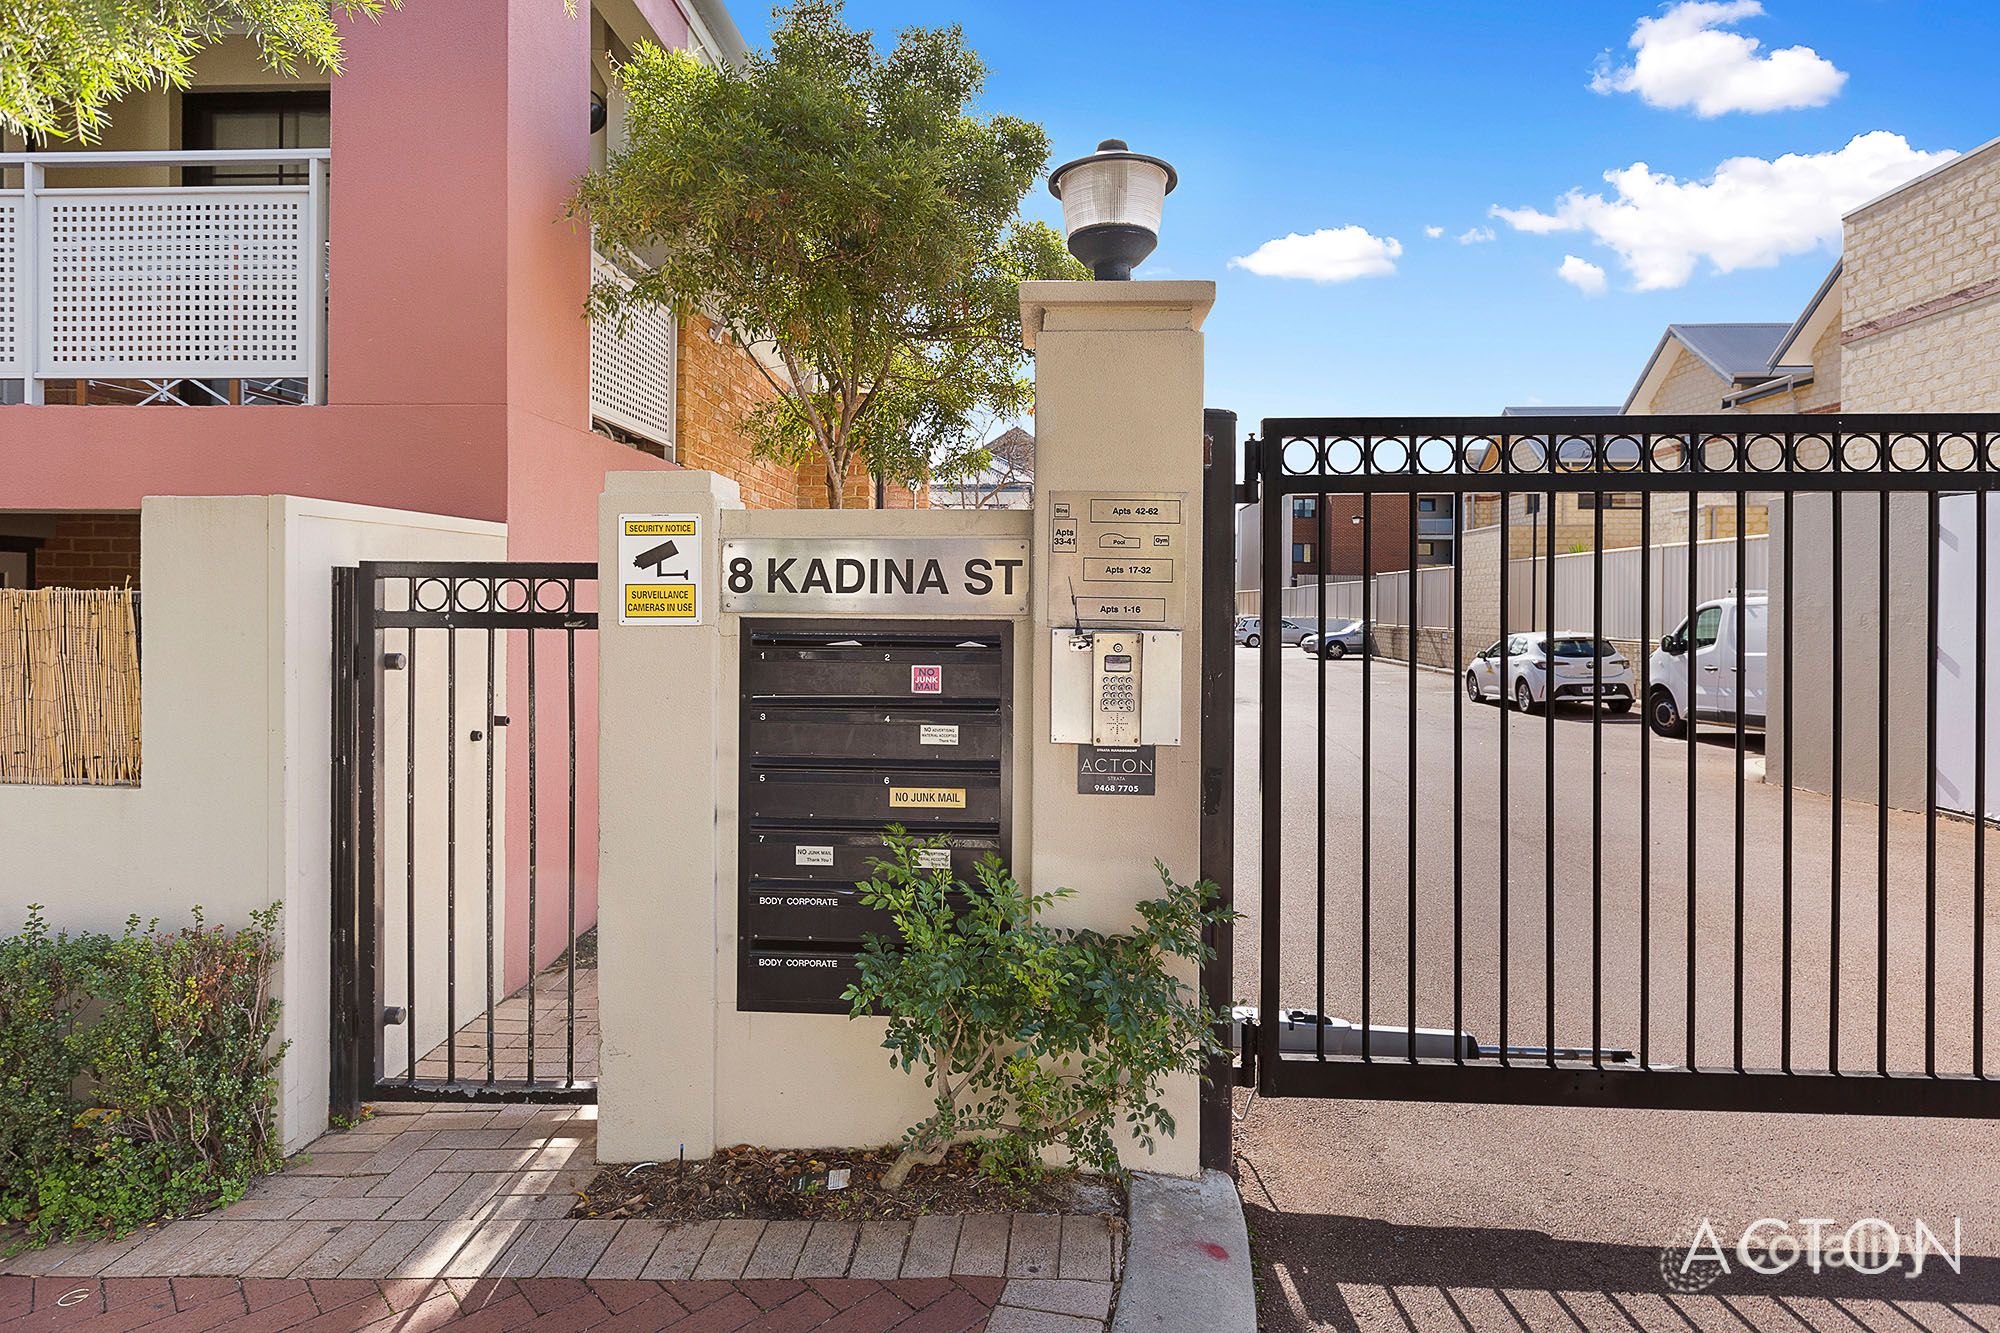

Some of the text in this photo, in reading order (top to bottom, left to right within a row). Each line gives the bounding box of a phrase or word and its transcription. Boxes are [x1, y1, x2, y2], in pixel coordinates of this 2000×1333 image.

[1112, 507, 1159, 516] Apts 42-62
[629, 524, 691, 533] SECURITY NOTICE
[1055, 528, 1074, 537] Apts
[1053, 537, 1076, 545] 33-41
[1105, 566, 1152, 575] Apts 17-32
[727, 557, 1023, 596] 8 KADINA ST
[631, 590, 689, 600] SURVEILLANCE
[627, 603, 693, 612] CAMERAS IN USE
[1100, 605, 1141, 614] Apts 1-16
[760, 651, 766, 660] 1
[884, 653, 891, 662] 2
[918, 668, 935, 676] NO
[915, 676, 938, 684] JUNK
[915, 683, 938, 691] MAIL
[759, 712, 766, 721] 3
[884, 714, 891, 723] 4
[1080, 757, 1153, 773] ACTON
[759, 774, 766, 783] 5
[883, 776, 890, 785] 6
[1094, 784, 1139, 793] 9468 7705
[895, 791, 960, 804] NO JUNK MAIL
[759, 834, 765, 843] 7
[759, 896, 839, 907] BODY CORPORATE
[758, 958, 838, 968] BODY CORPORATE
